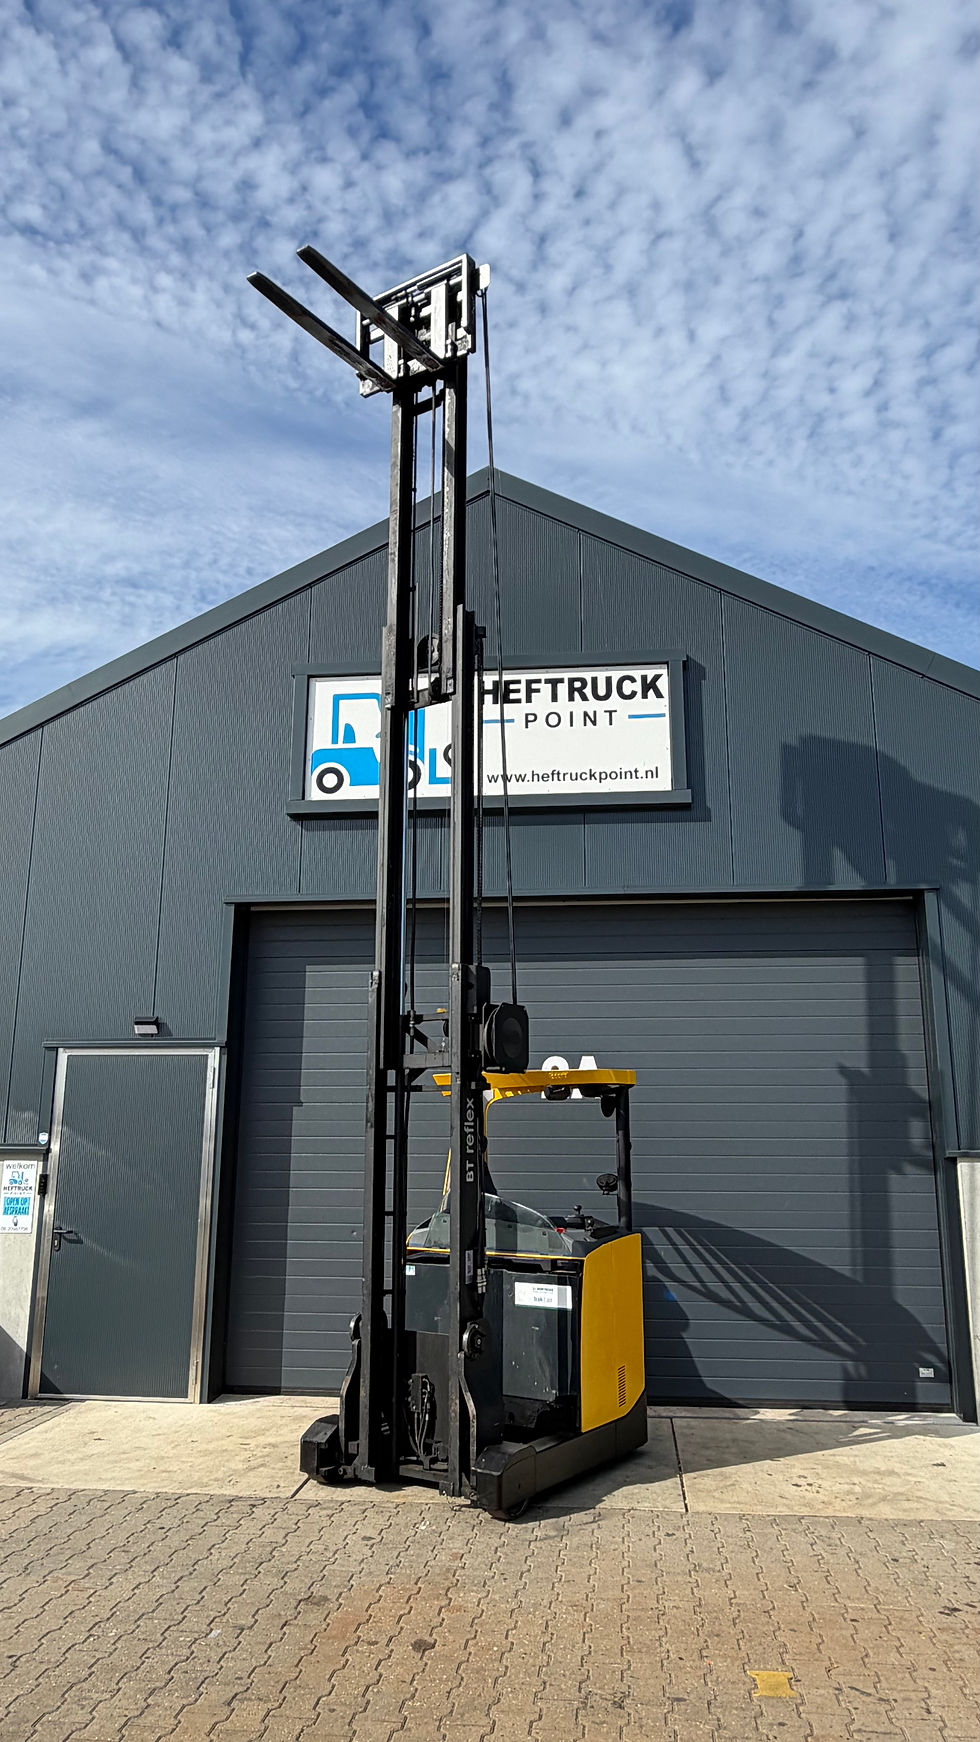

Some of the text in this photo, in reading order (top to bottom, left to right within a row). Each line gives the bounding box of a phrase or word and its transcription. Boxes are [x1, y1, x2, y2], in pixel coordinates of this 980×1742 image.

[482, 673, 665, 705] HEFTRUCK
[524, 709, 618, 729] POINT
[486, 766, 659, 784] www.heftruckpoint.nl
[464, 1097, 475, 1182] BT reflex
